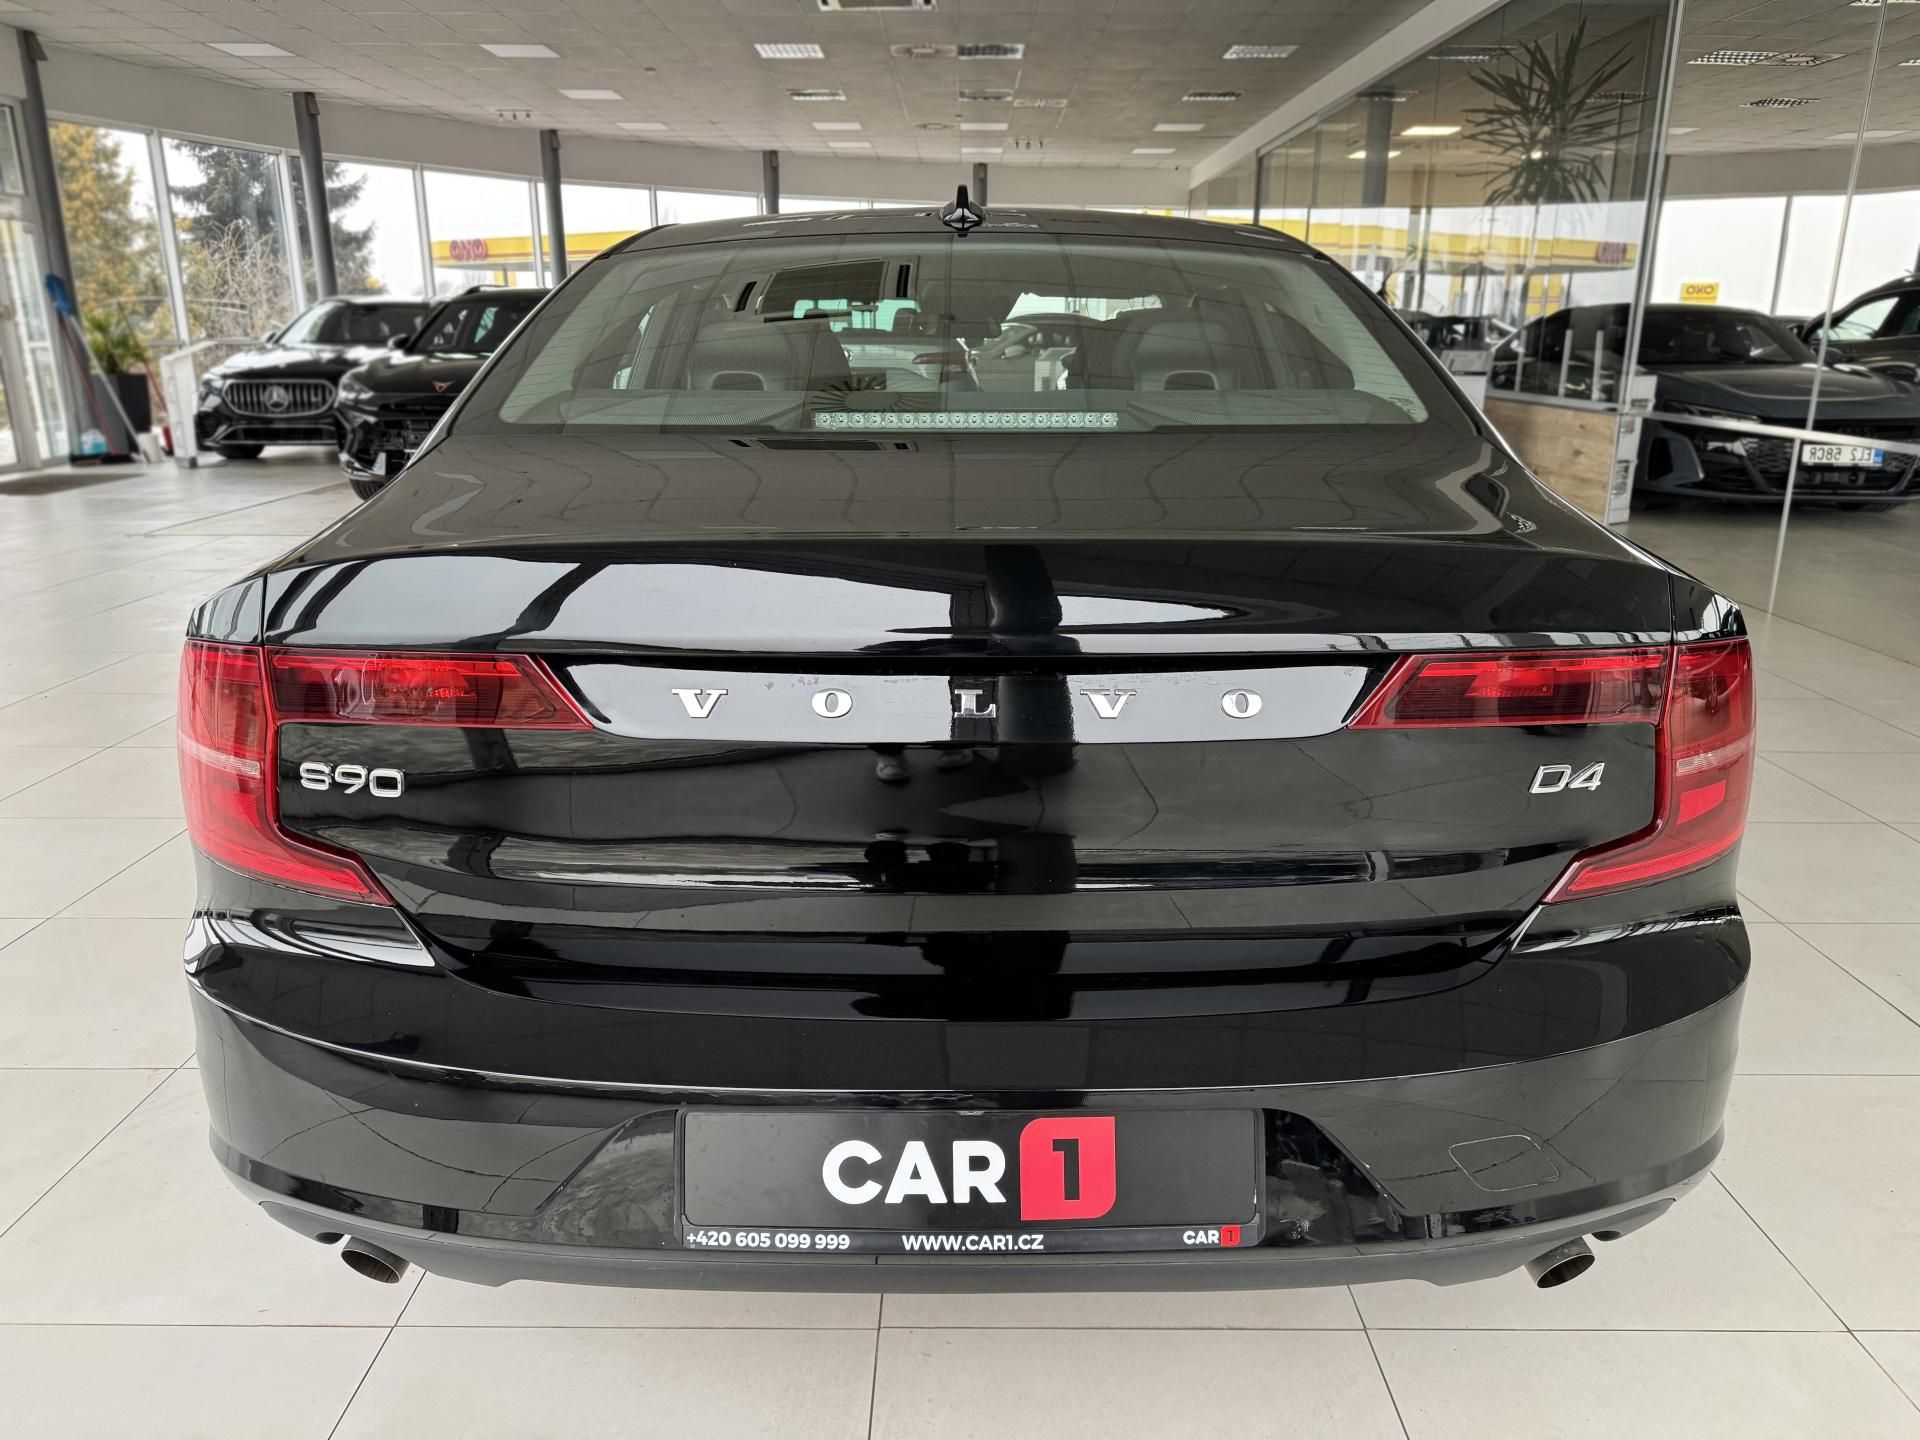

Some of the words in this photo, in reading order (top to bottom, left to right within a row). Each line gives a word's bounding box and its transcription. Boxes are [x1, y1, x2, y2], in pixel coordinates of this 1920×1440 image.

[672, 688, 1262, 720] VOLVO
[300, 761, 405, 797] S90
[1529, 761, 1605, 793] D4
[686, 1231, 731, 1246] +420
[735, 1232, 770, 1247] 605
[775, 1233, 811, 1249] 099
[815, 1234, 850, 1250] 999
[901, 1234, 1044, 1251] WWW.CAR1.CZ
